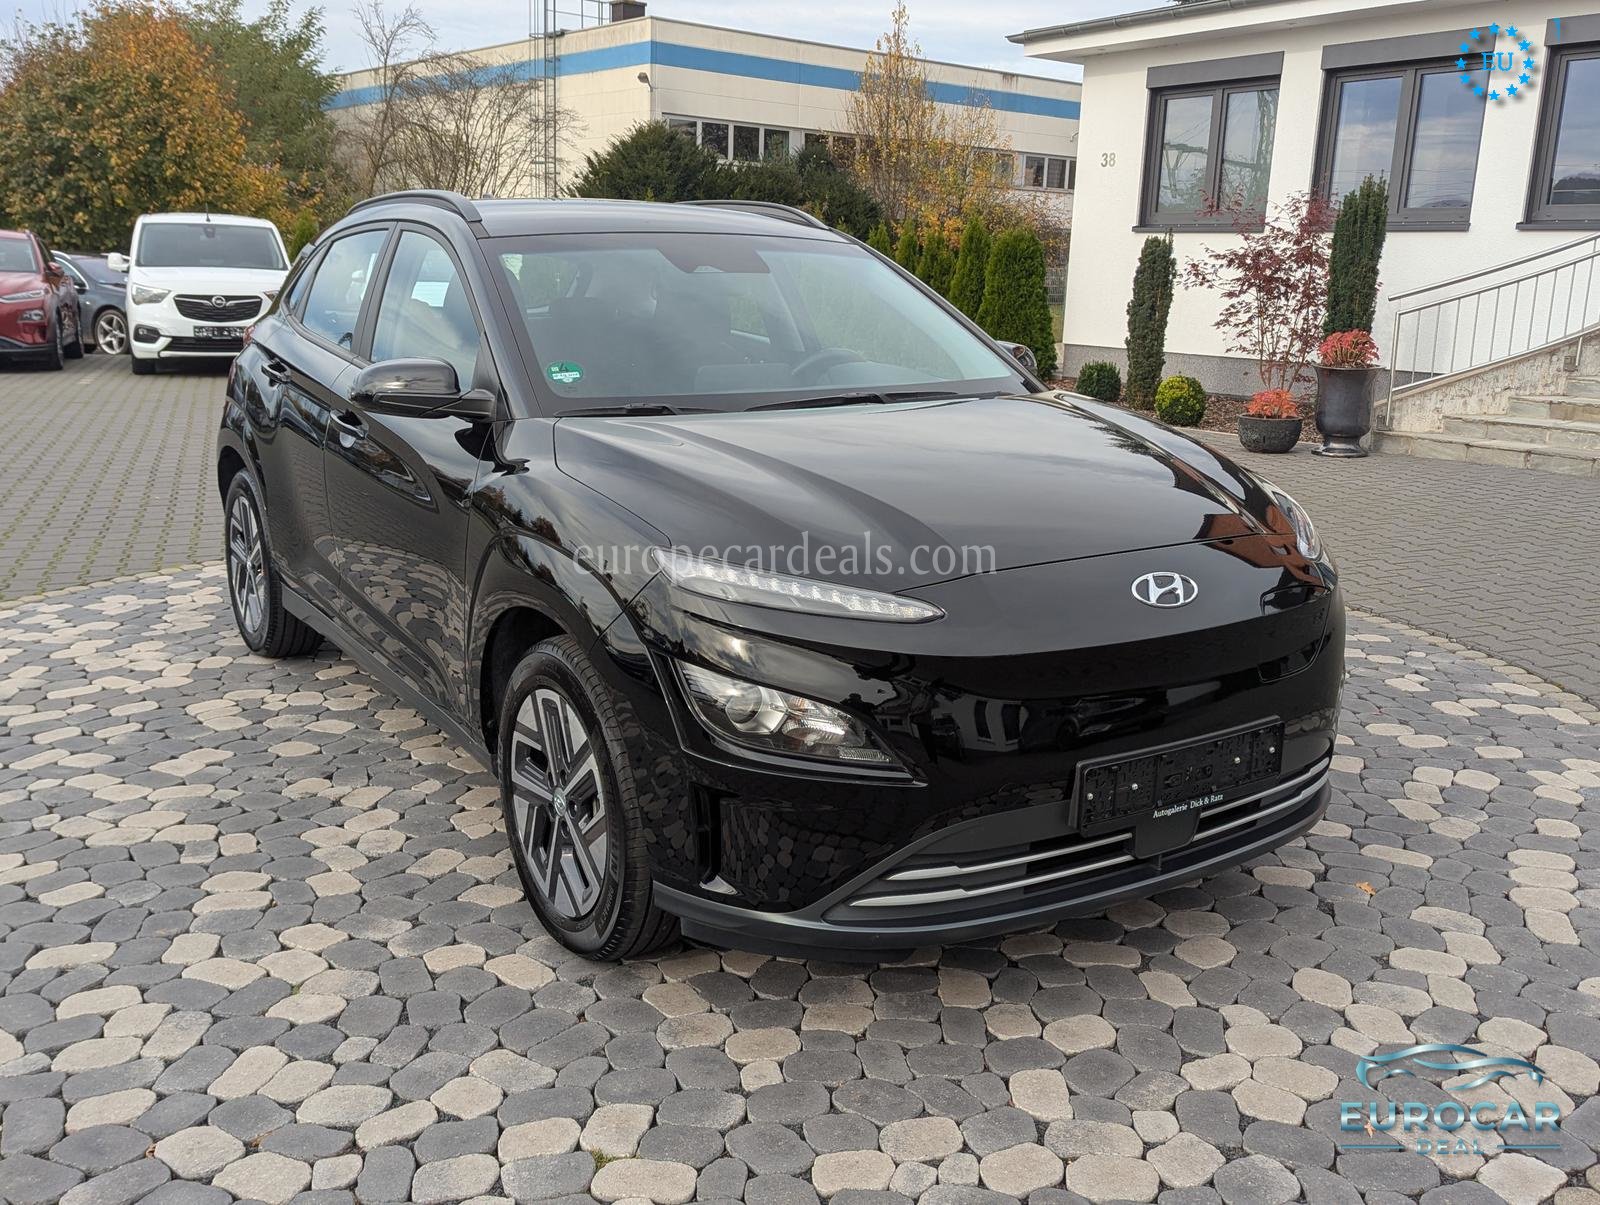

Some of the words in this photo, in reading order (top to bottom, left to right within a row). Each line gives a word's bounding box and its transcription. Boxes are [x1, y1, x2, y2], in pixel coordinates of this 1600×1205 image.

[1101, 152, 1116, 168] 38
[1153, 803, 1188, 818] Autogalerie
[1190, 798, 1204, 809] Dick
[1204, 796, 1210, 805] &
